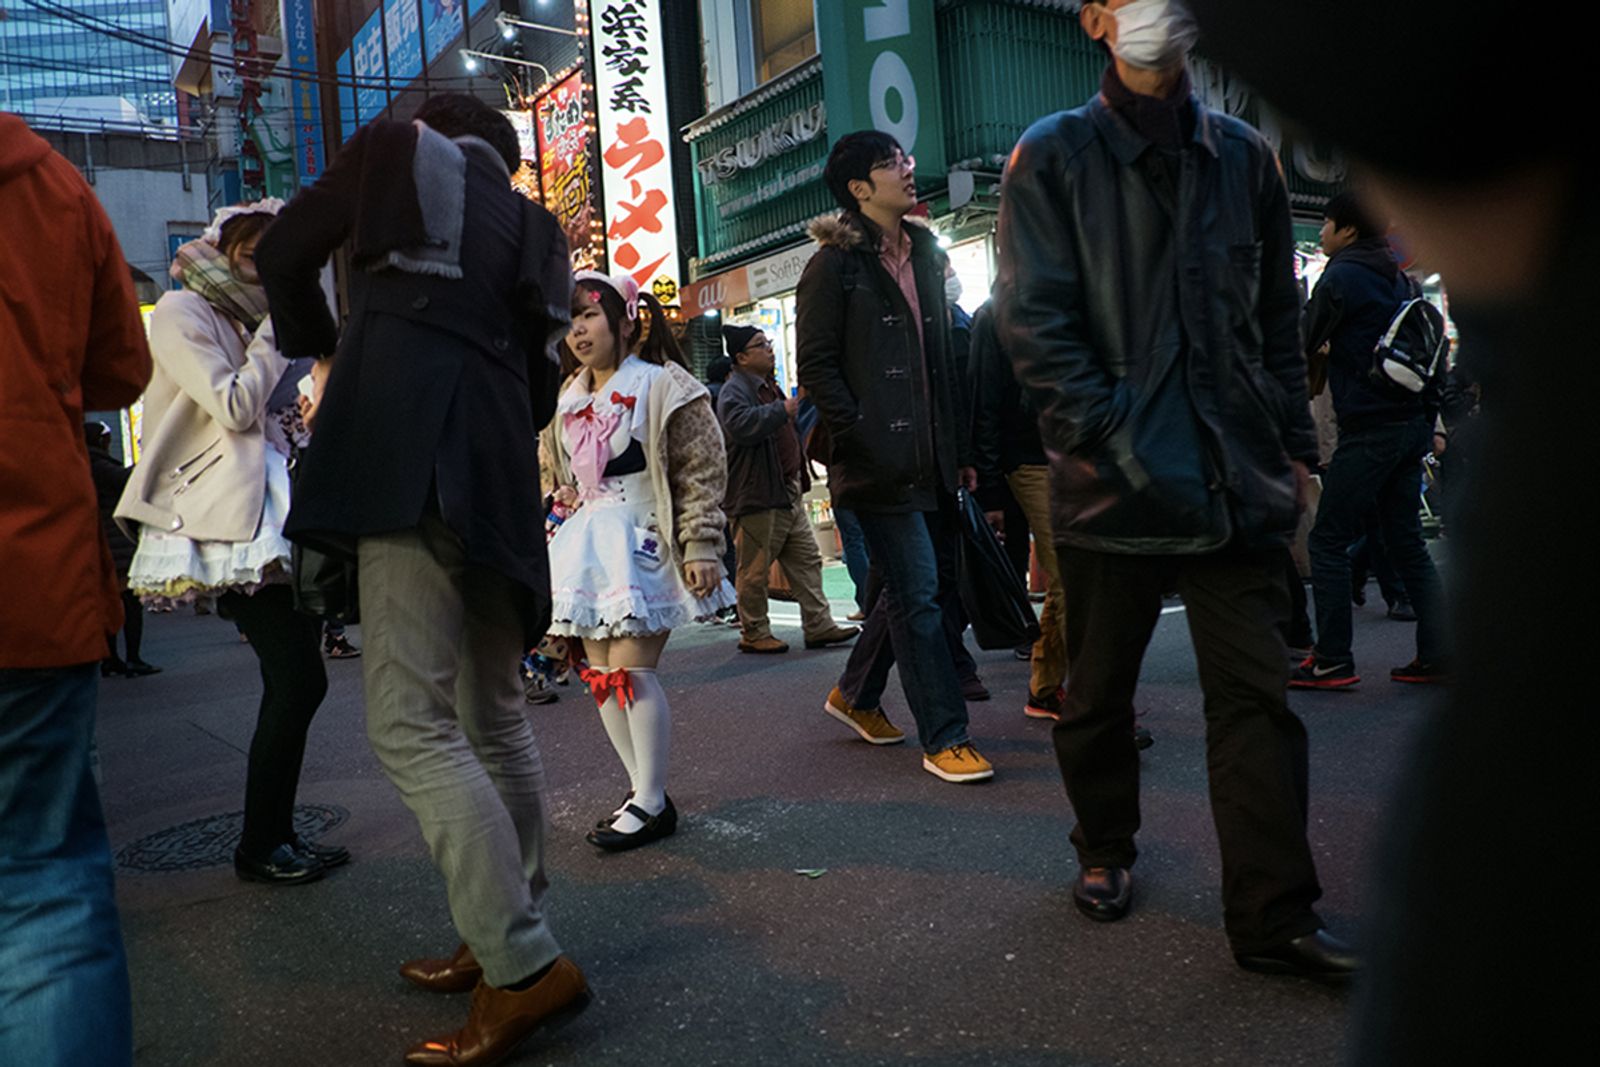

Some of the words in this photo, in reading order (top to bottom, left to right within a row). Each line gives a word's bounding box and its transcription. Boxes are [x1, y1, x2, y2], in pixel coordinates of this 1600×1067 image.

[600, 0, 672, 288] 浜家系ラーメン
[698, 100, 827, 186] TSUKU
[698, 280, 727, 308] au
[769, 256, 808, 282] SoftB
